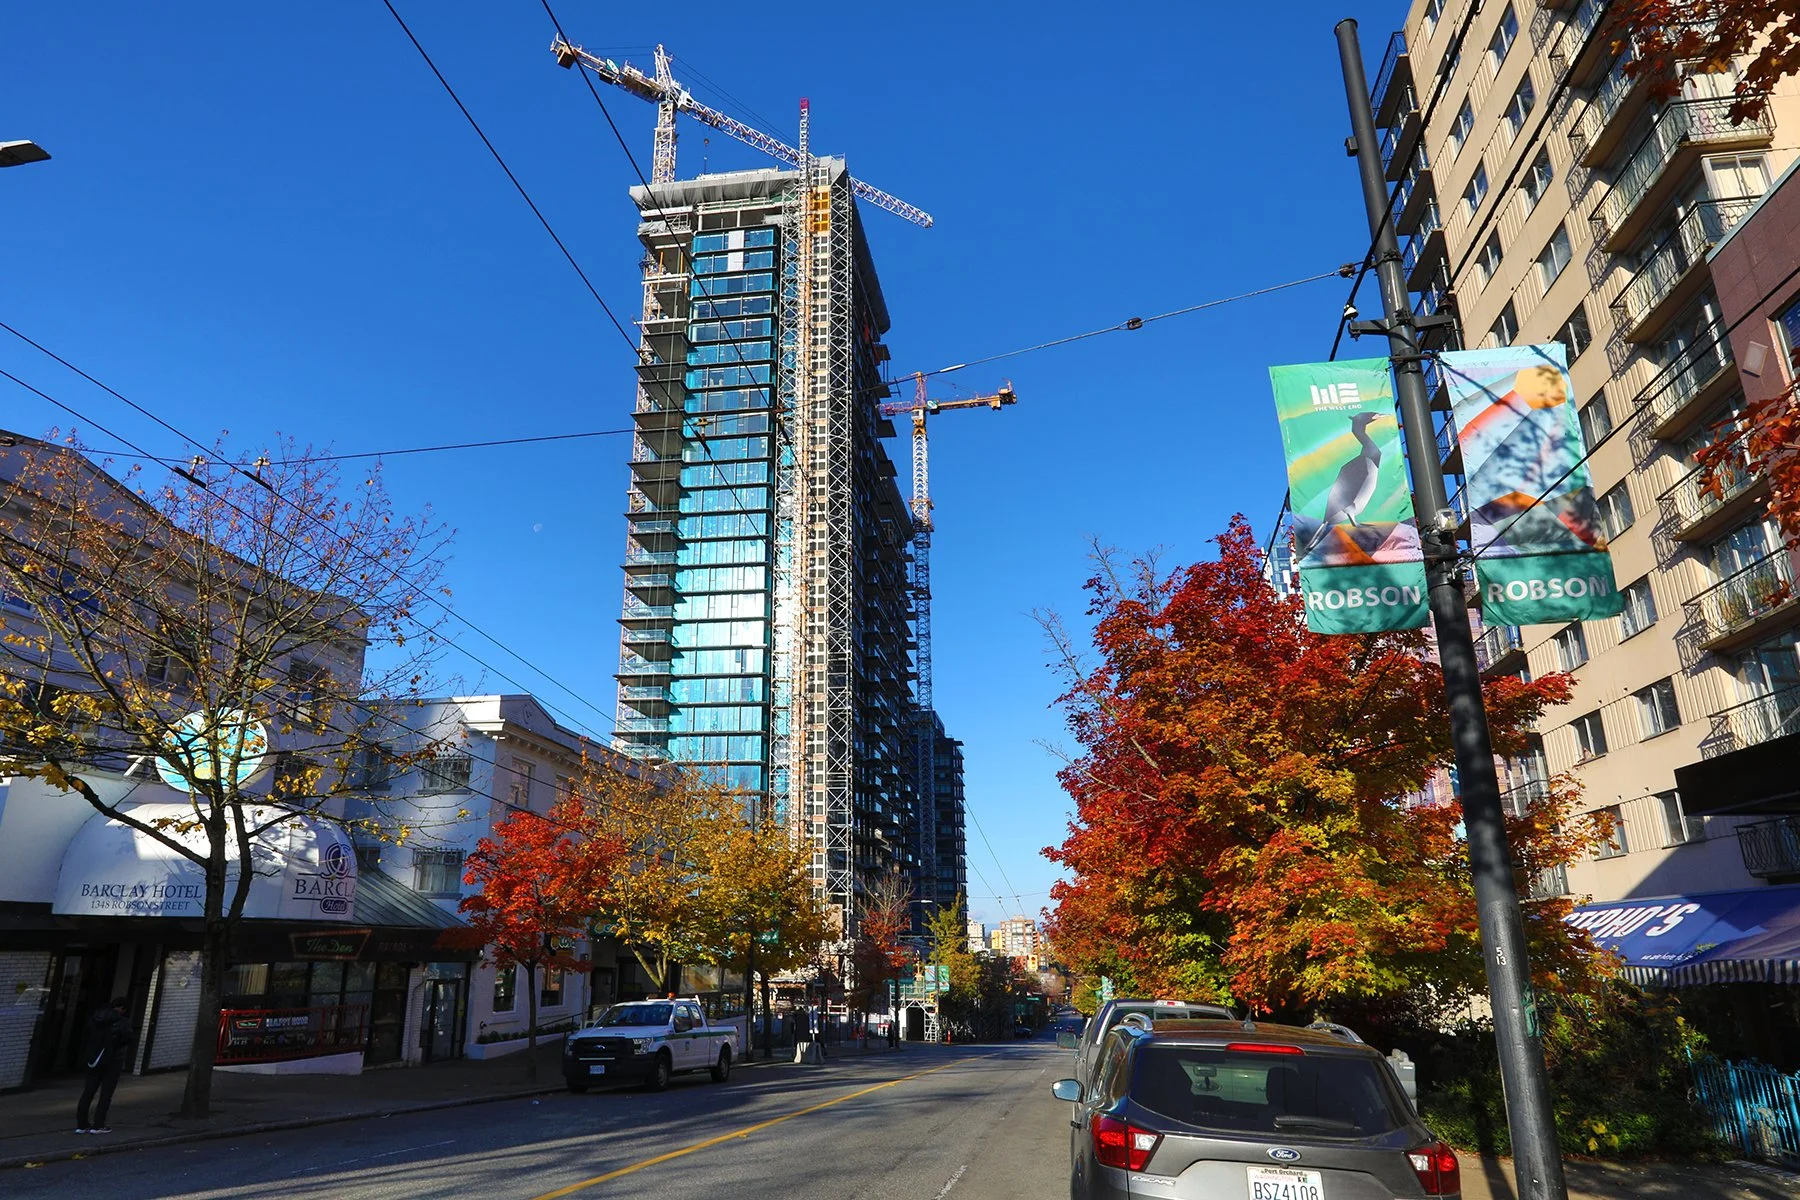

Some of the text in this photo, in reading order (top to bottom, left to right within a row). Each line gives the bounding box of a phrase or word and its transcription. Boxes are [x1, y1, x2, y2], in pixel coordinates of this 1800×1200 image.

[1487, 574, 1611, 603] ROBSON
[1307, 584, 1421, 612] ROBSON
[81, 883, 203, 899] BARCLAY HOTEL
[91, 900, 190, 911] 1348 ROBSON STREET
[305, 937, 353, 953] The Den
[1496, 947, 1503, 957] 5
[1496, 956, 1507, 966] 13
[1253, 1181, 1319, 1200] BSZ4108
